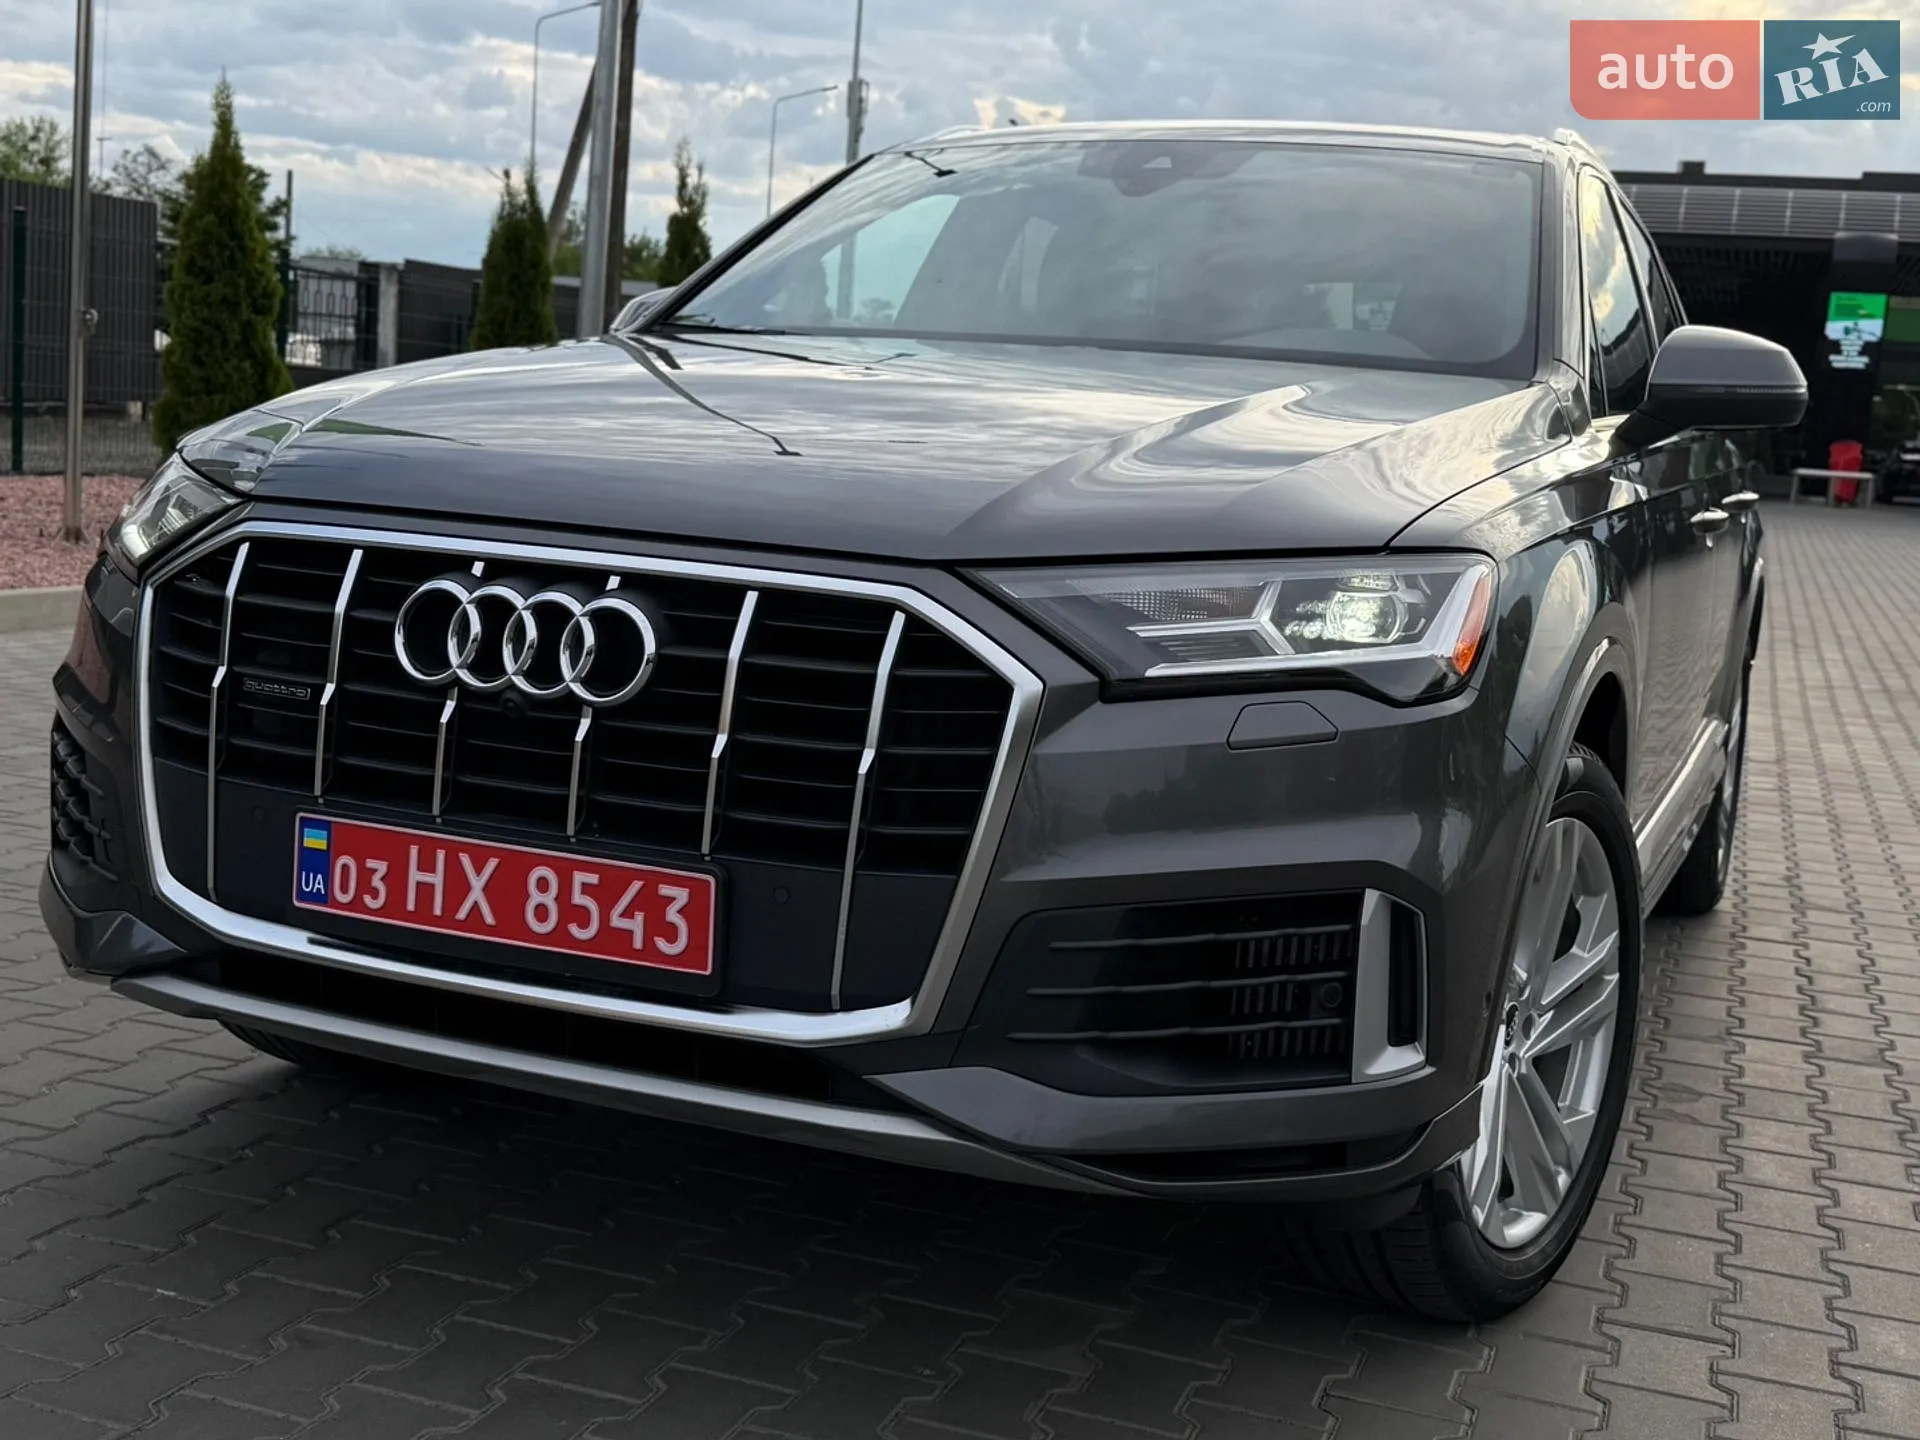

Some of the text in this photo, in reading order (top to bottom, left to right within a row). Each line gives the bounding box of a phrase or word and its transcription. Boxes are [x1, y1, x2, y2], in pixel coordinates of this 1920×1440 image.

[244, 680, 307, 697] quattro
[301, 871, 326, 895] UA
[333, 844, 691, 957] 03 HX 8543
